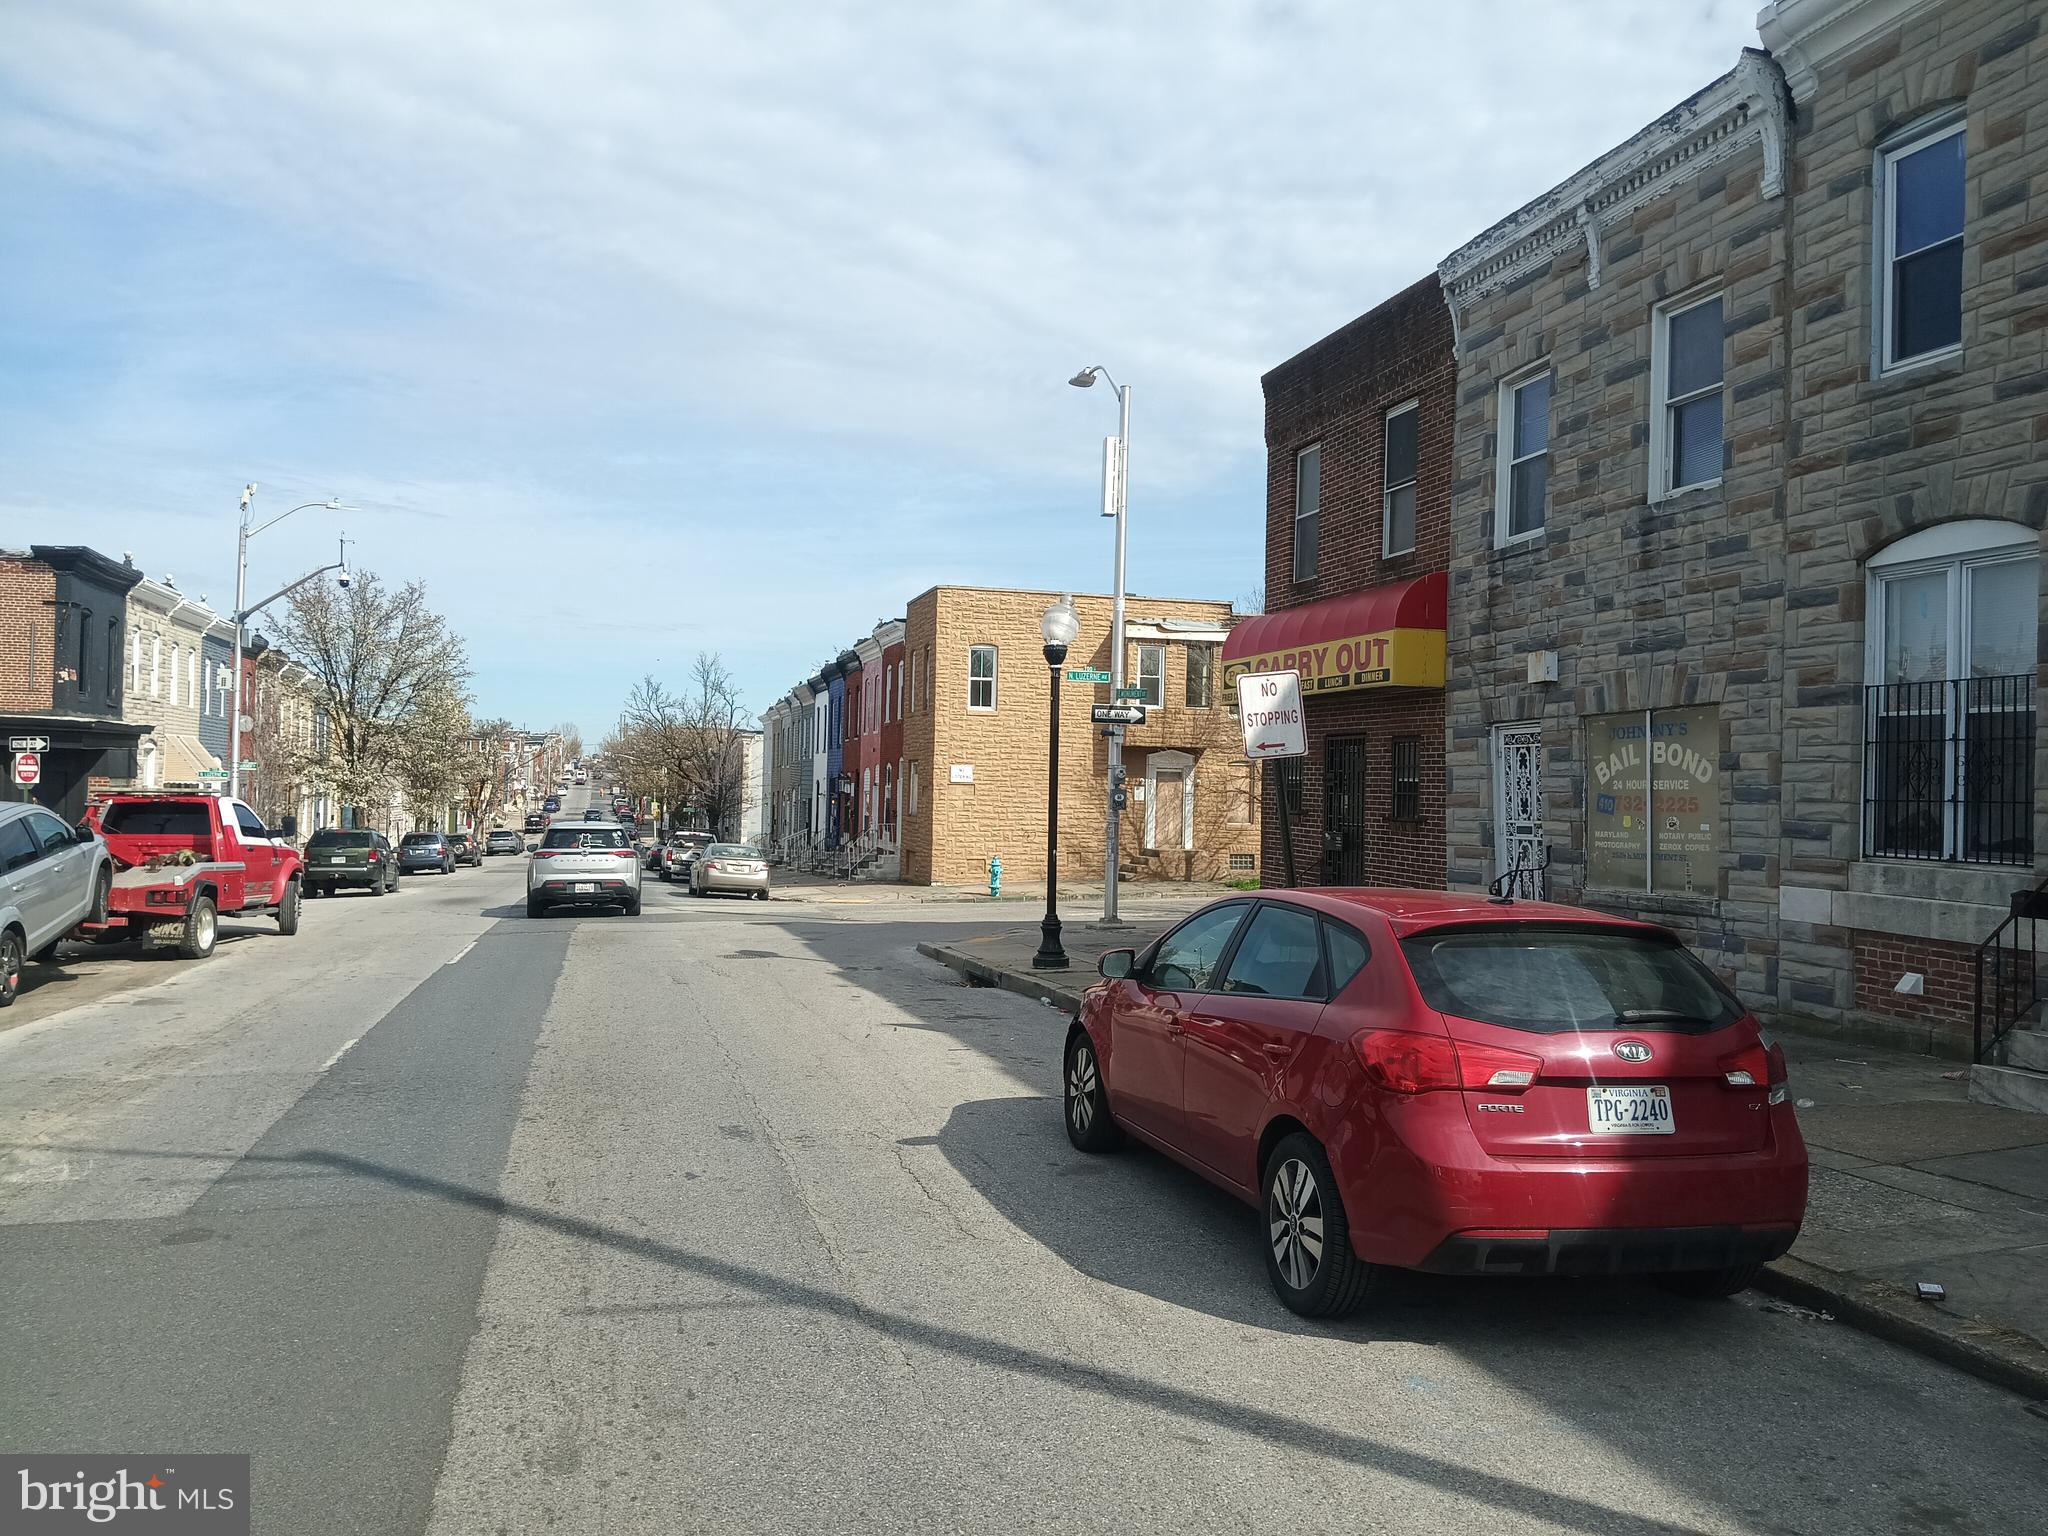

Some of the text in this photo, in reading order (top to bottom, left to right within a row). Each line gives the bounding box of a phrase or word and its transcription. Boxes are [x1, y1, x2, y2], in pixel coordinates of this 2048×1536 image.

[1336, 638, 1389, 673] OUT
[1324, 676, 1343, 687] LUNCH
[1361, 671, 1383, 682] DINNER
[1261, 682, 1277, 697] NO
[1096, 710, 1112, 718] ONE
[1247, 709, 1299, 727] STOPPING
[1595, 742, 1713, 785] BAIL BOND
[1613, 780, 1622, 790] 24
[1652, 780, 1689, 790] SERVICE
[1659, 832, 1712, 841] NOTARY PUBLIC
[1594, 841, 1641, 849] PHOTOGRAPHY
[1621, 1046, 1648, 1058] KIA
[1608, 1089, 1648, 1097] VIRGINIA
[1478, 1104, 1525, 1112] FORTE
[1594, 1099, 1668, 1121] TPG-2240
